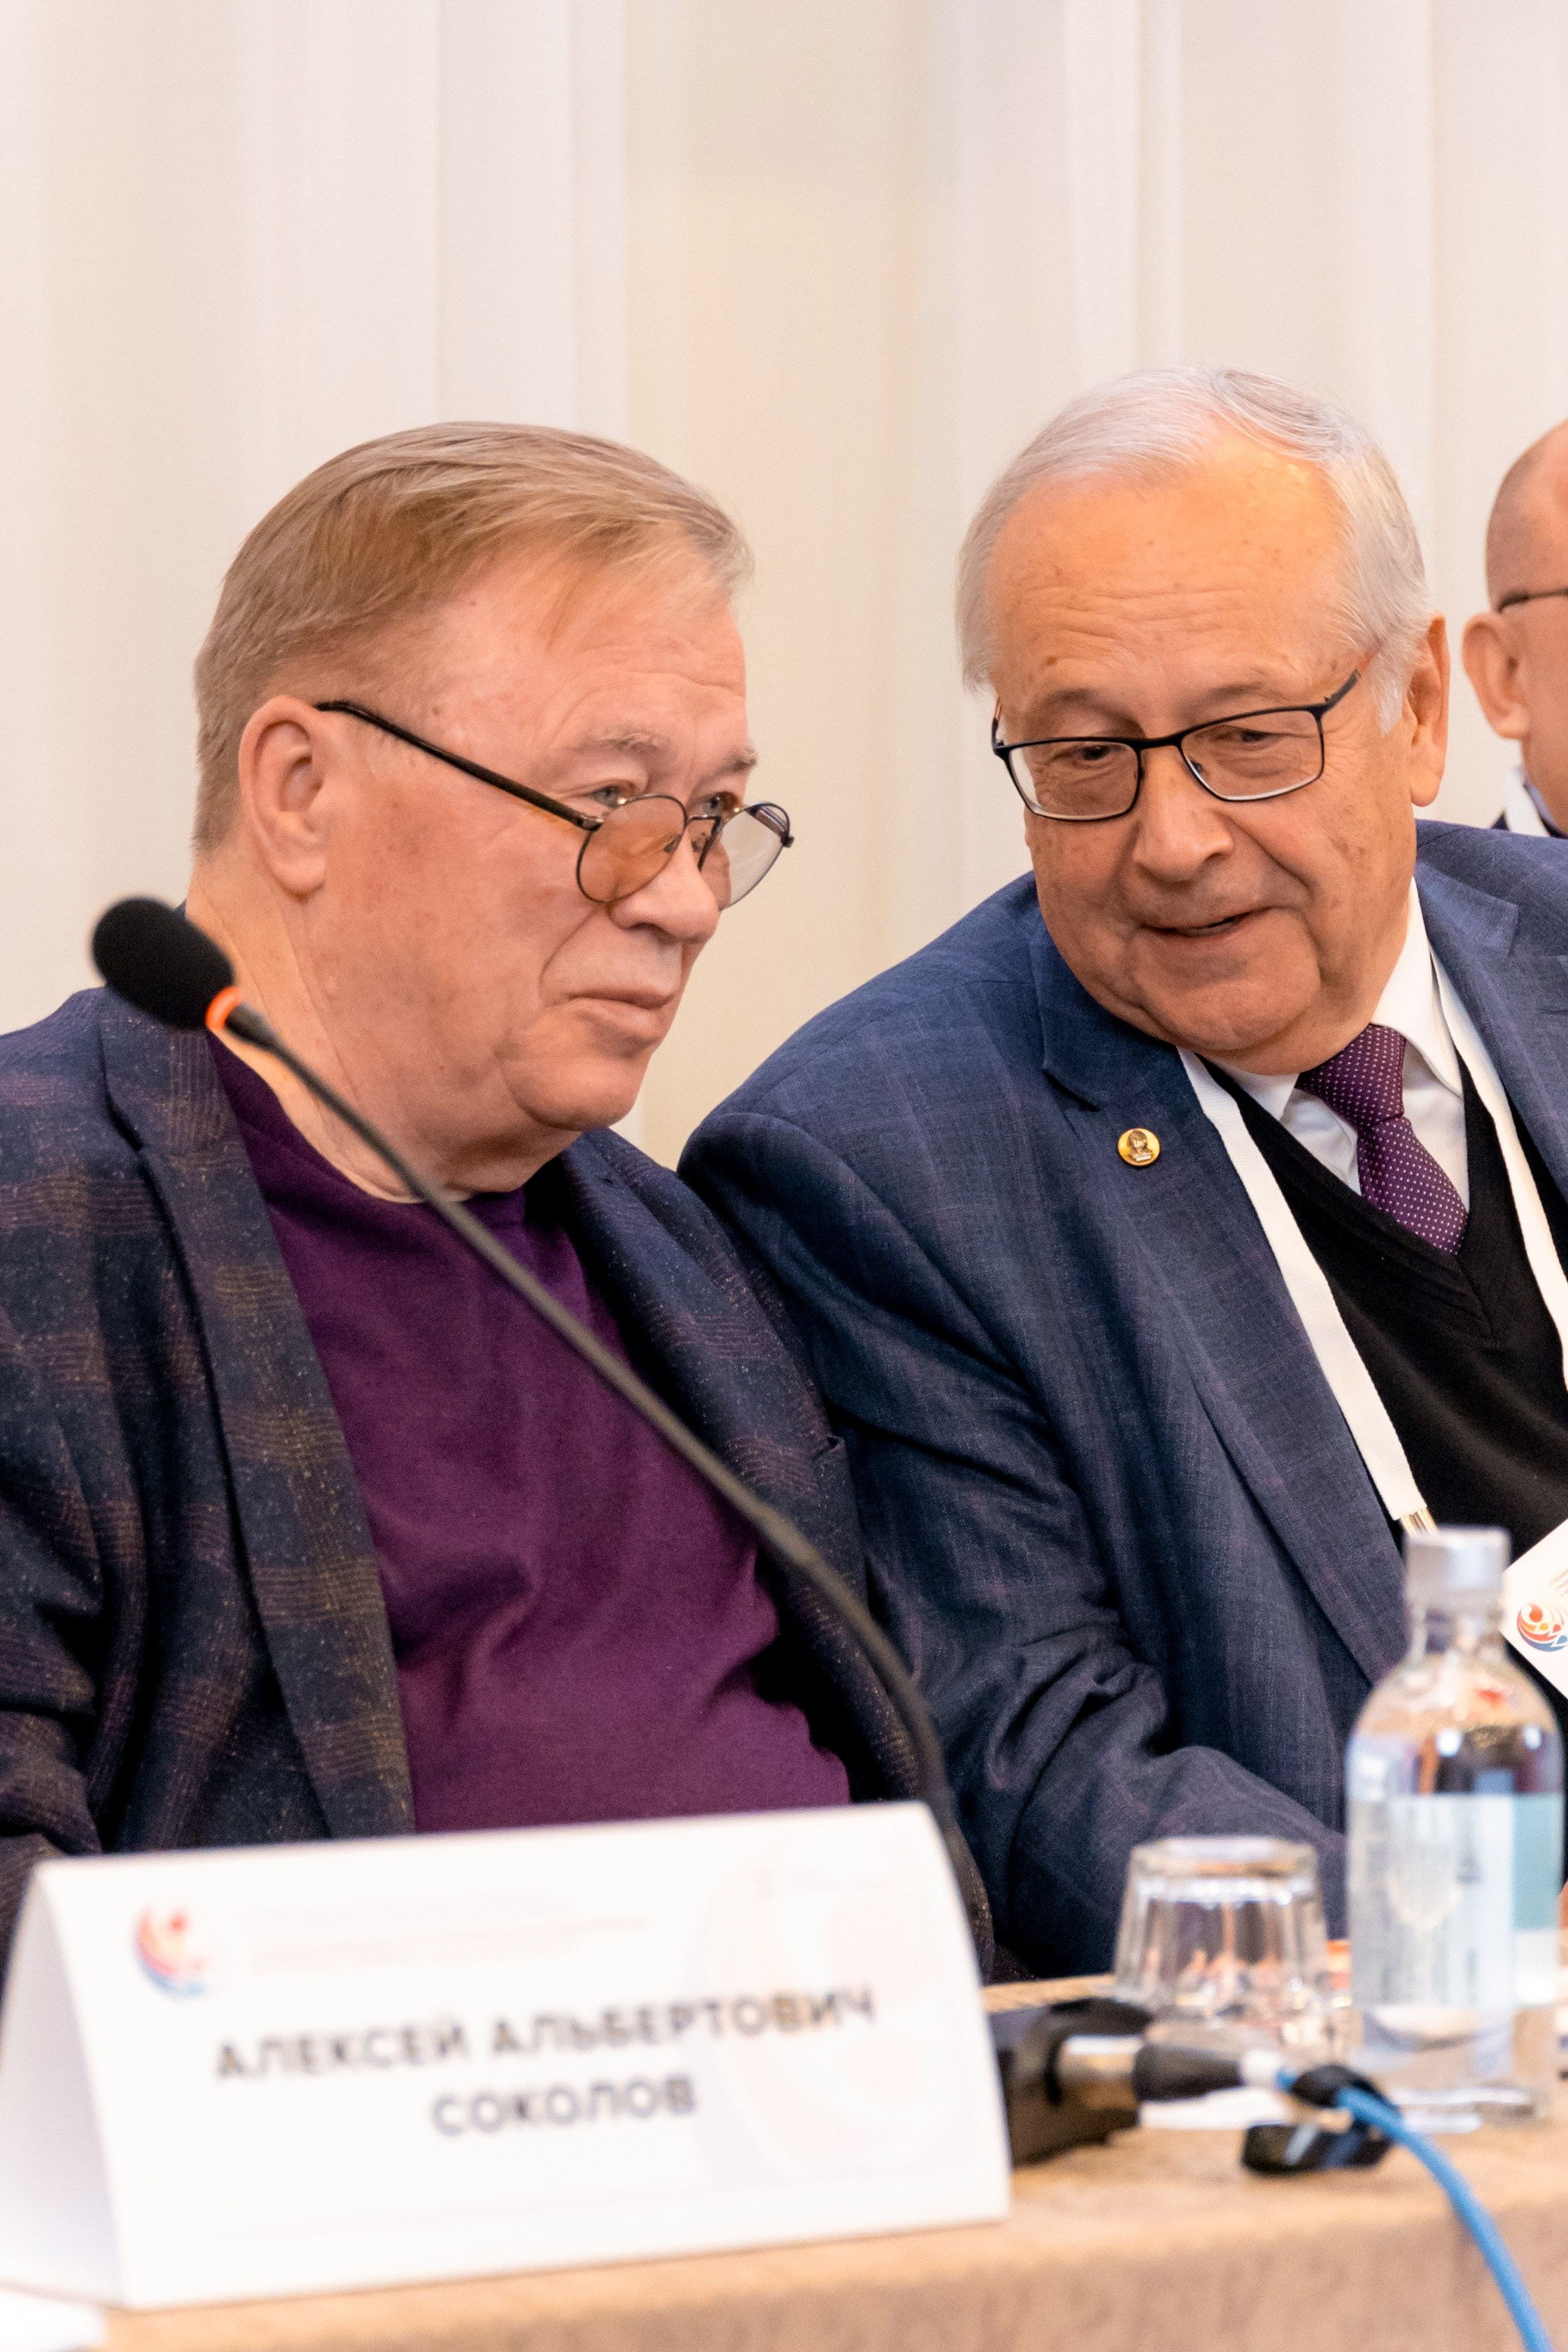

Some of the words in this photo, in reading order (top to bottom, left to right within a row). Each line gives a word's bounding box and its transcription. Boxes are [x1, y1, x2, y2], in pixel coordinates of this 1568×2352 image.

[216, 2015, 467, 2083] АЛЕКСЕЙ
[491, 1987, 874, 2058] АЛЬБЕРТОВИЧ
[431, 2075, 697, 2137] СОКОЛОВ
